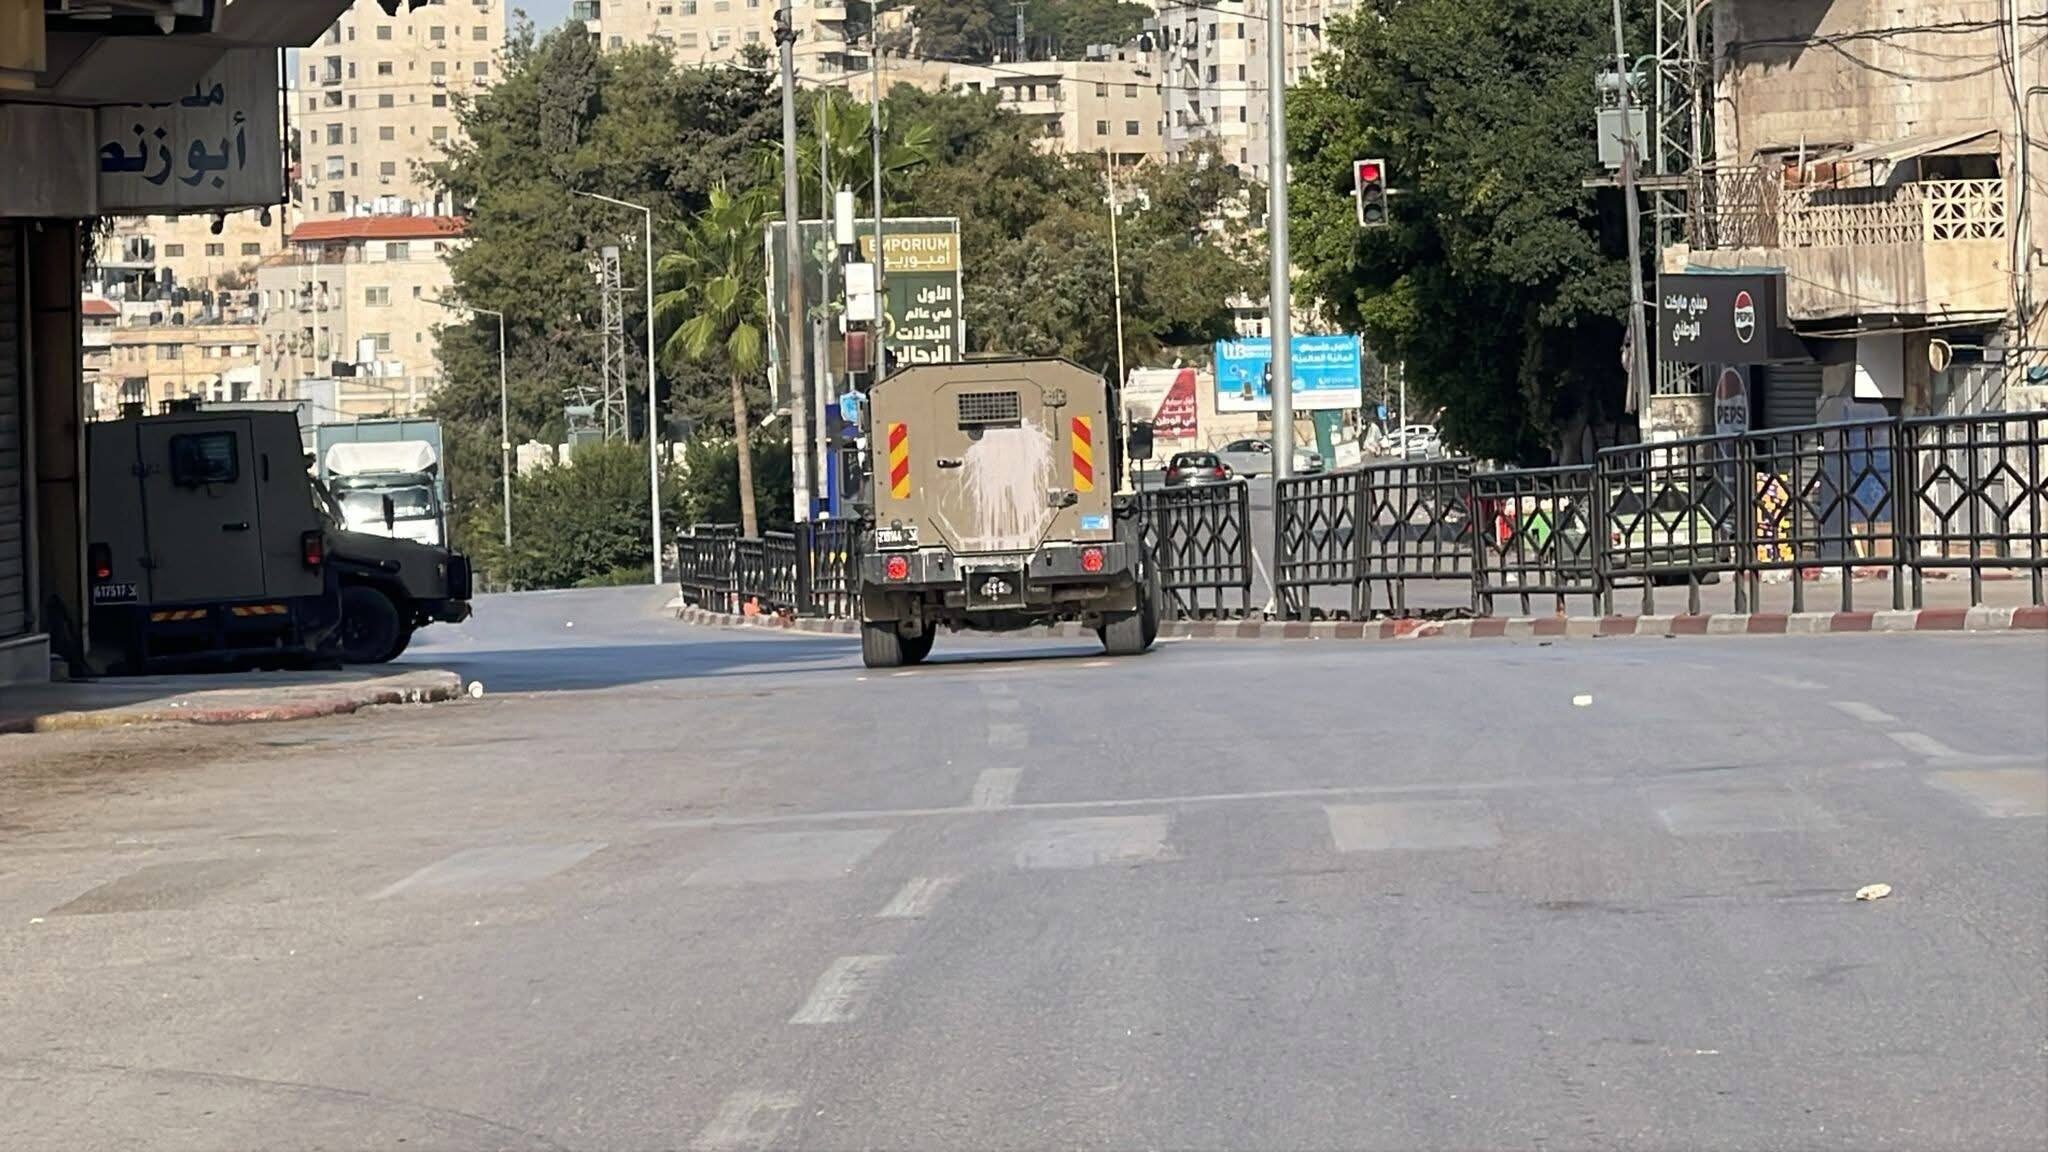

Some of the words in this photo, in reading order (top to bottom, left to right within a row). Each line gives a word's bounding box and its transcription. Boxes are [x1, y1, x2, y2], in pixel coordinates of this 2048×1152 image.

[178, 110, 246, 187] أبو
[869, 237, 950, 251] EMPORIUM
[917, 284, 951, 304] الأول
[1664, 294, 1687, 314] ماركت
[905, 307, 930, 322] عالم
[932, 307, 952, 323] في
[896, 325, 951, 343] البدلات
[1673, 320, 1700, 346] الوطني
[1717, 405, 1747, 425] PEPSI
